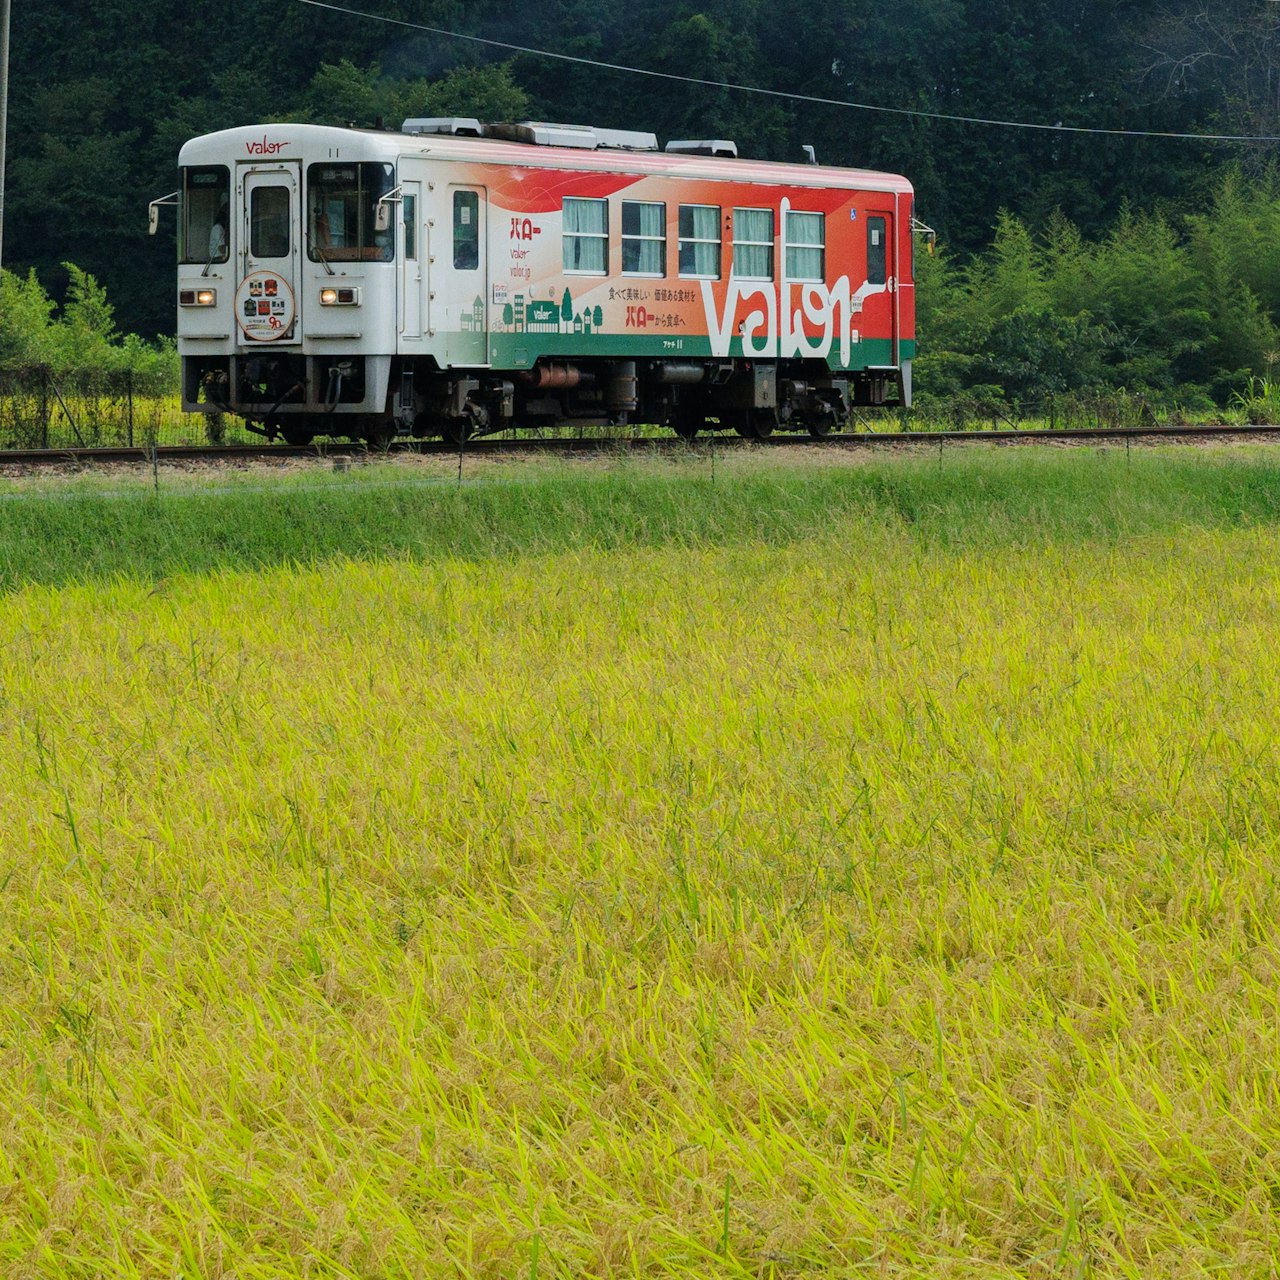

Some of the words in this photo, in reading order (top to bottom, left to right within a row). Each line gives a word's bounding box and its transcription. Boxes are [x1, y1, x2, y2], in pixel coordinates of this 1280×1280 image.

[246, 135, 291, 155] valor
[510, 217, 541, 240] バロー
[699, 196, 886, 368] valor
[269, 316, 282, 329] 90
